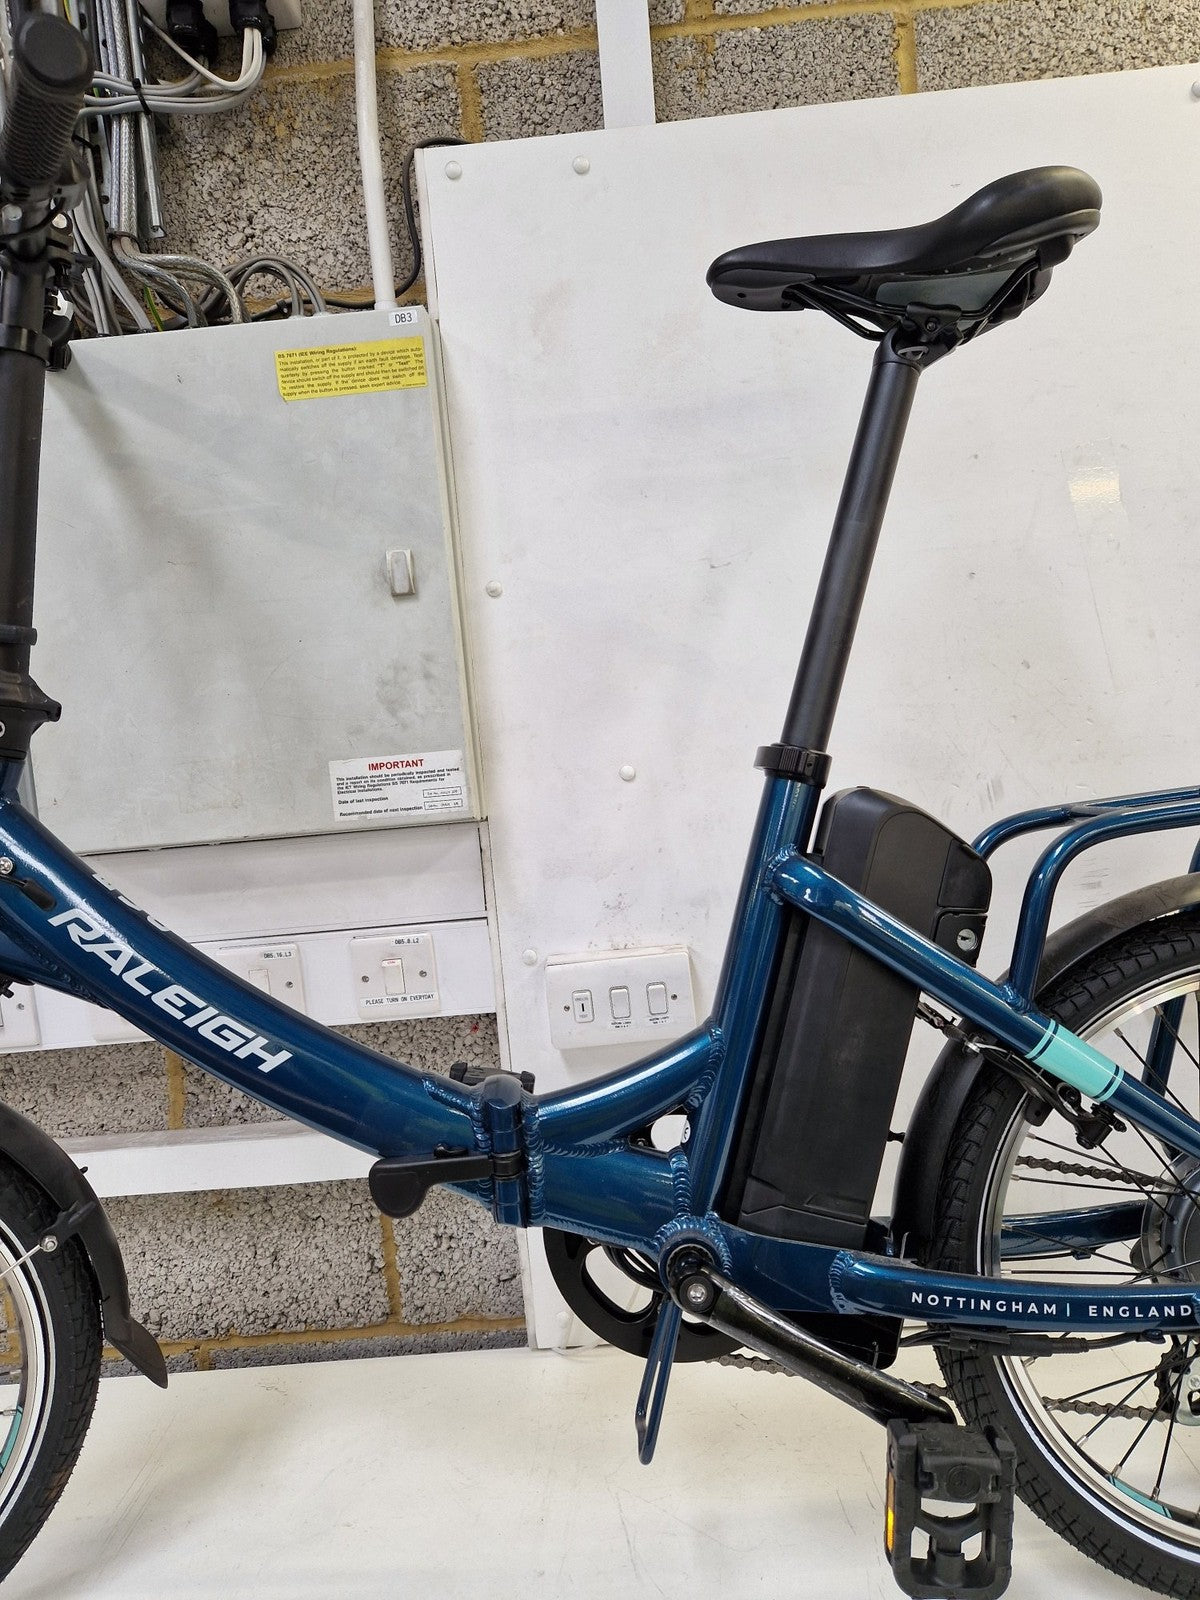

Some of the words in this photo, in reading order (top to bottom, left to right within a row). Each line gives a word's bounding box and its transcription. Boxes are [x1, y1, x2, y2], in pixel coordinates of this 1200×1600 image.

[395, 312, 412, 324] DB3
[368, 758, 424, 771] IMPORTANT
[47, 908, 293, 1073] RALEIGH
[911, 1291, 1057, 1316] NOTTINGHAM
[1088, 1304, 1192, 1318] ENGLAND
